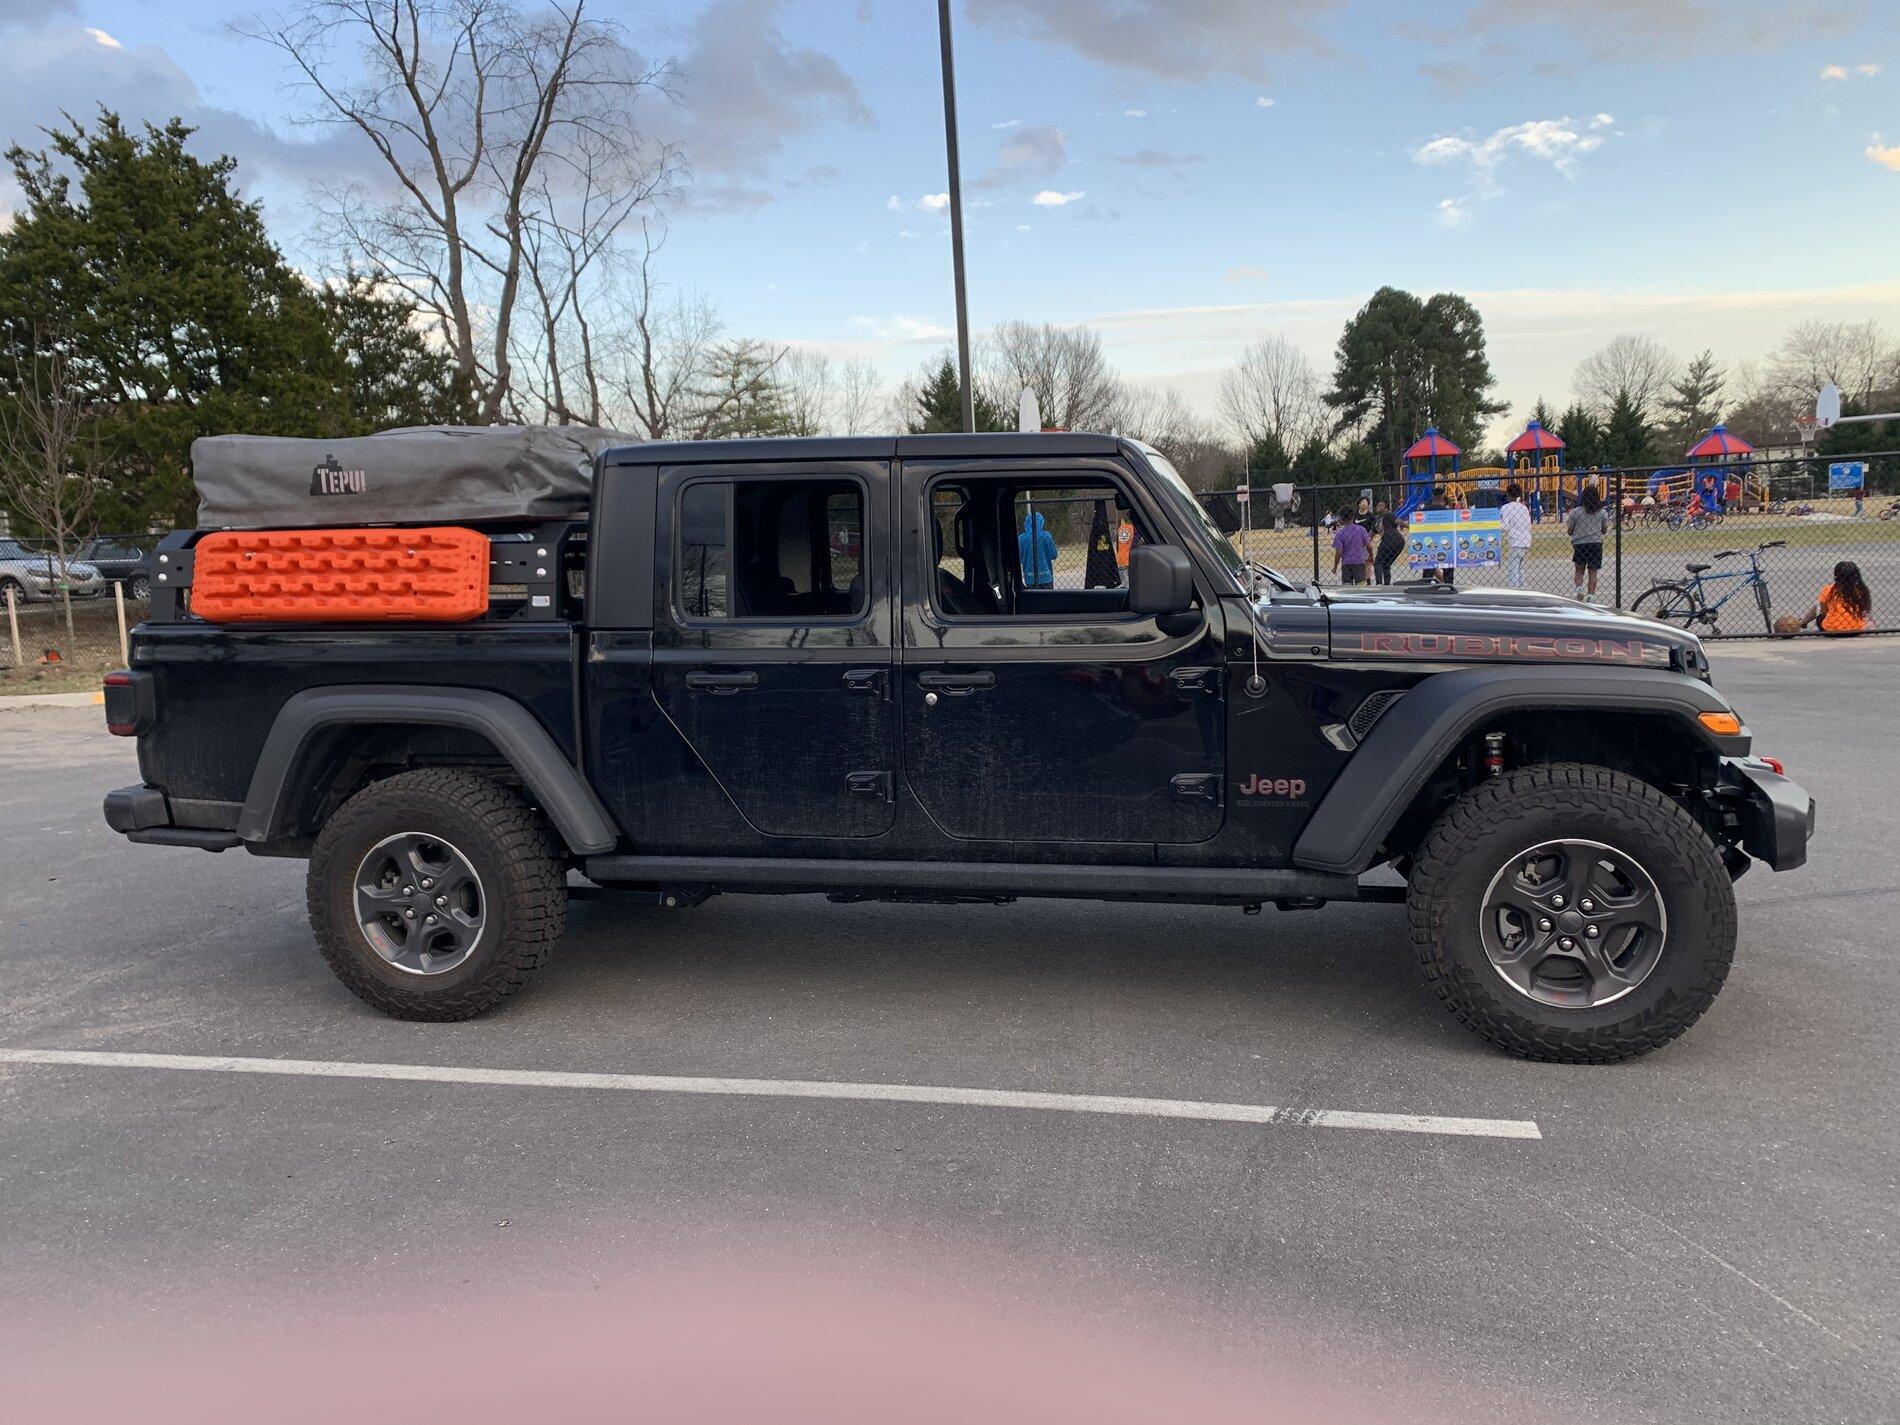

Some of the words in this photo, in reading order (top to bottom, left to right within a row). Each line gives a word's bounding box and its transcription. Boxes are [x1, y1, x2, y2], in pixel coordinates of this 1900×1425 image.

[317, 468, 366, 493] TEPUI
[1360, 633, 1644, 660] RUBICON
[1240, 773, 1306, 799] Jeep
